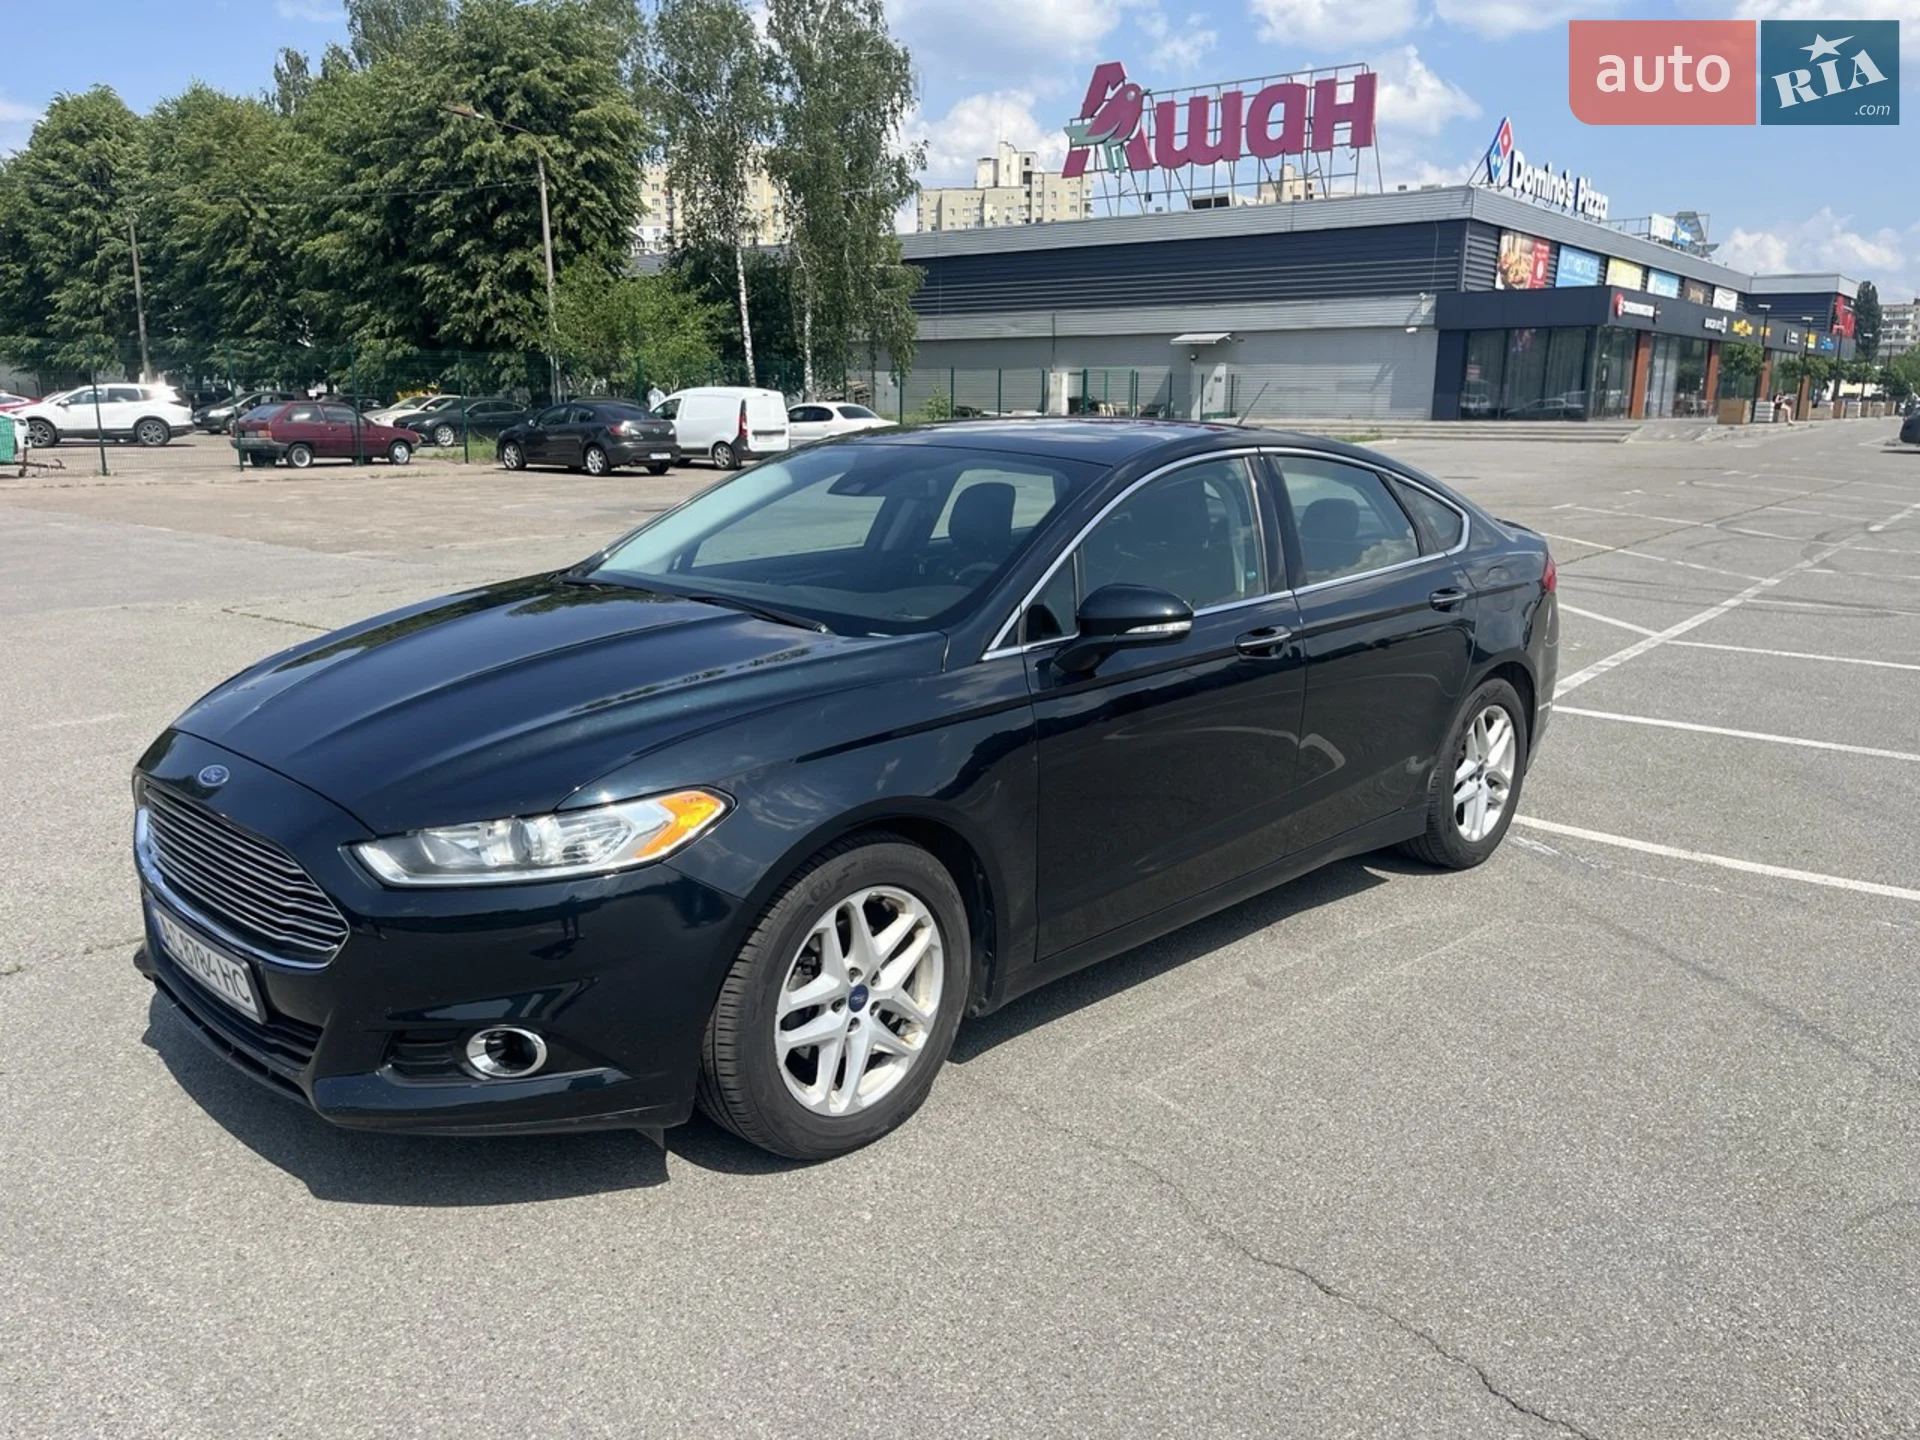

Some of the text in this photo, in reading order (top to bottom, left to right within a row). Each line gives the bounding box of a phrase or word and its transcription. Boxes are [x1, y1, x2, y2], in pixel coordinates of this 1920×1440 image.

[1062, 61, 1378, 179] Ашан
[1509, 148, 1609, 221] Domino's Pizza
[216, 957, 251, 1003] HC
